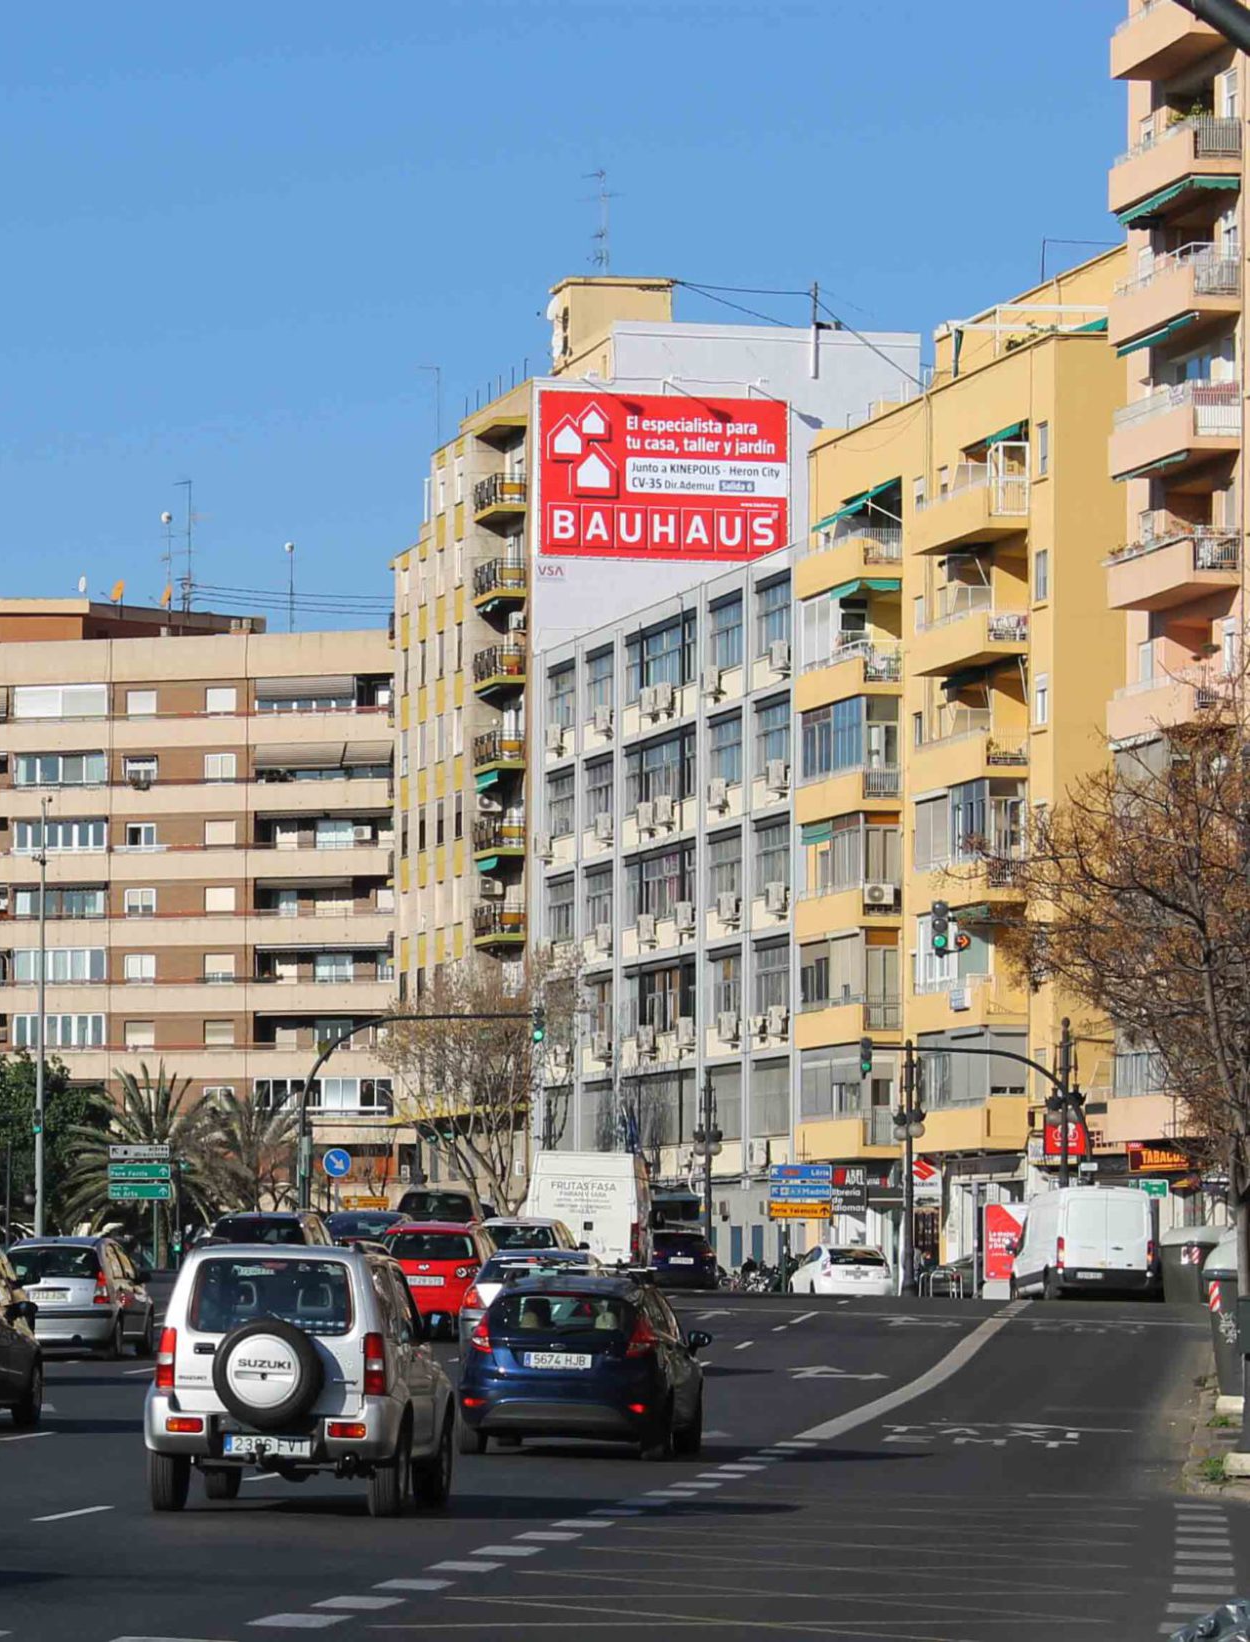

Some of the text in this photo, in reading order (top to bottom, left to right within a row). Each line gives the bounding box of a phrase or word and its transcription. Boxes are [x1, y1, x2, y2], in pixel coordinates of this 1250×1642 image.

[626, 416, 758, 436] El especialista para
[625, 435, 776, 456] tu casa, taller y jardín
[631, 461, 659, 474] Junto
[661, 465, 667, 473] a
[669, 462, 721, 476] KINEPOLIS
[728, 465, 759, 477] Heron
[761, 467, 780, 479] City
[631, 476, 662, 489] CV-35
[552, 509, 775, 547] BAUHAUS
[550, 1181, 617, 1191] FRUTAS FASA
[237, 1358, 292, 1371] SUZUKI
[533, 1353, 586, 1366] 5674 HJB
[882, 1425, 1080, 1439] TAXI
